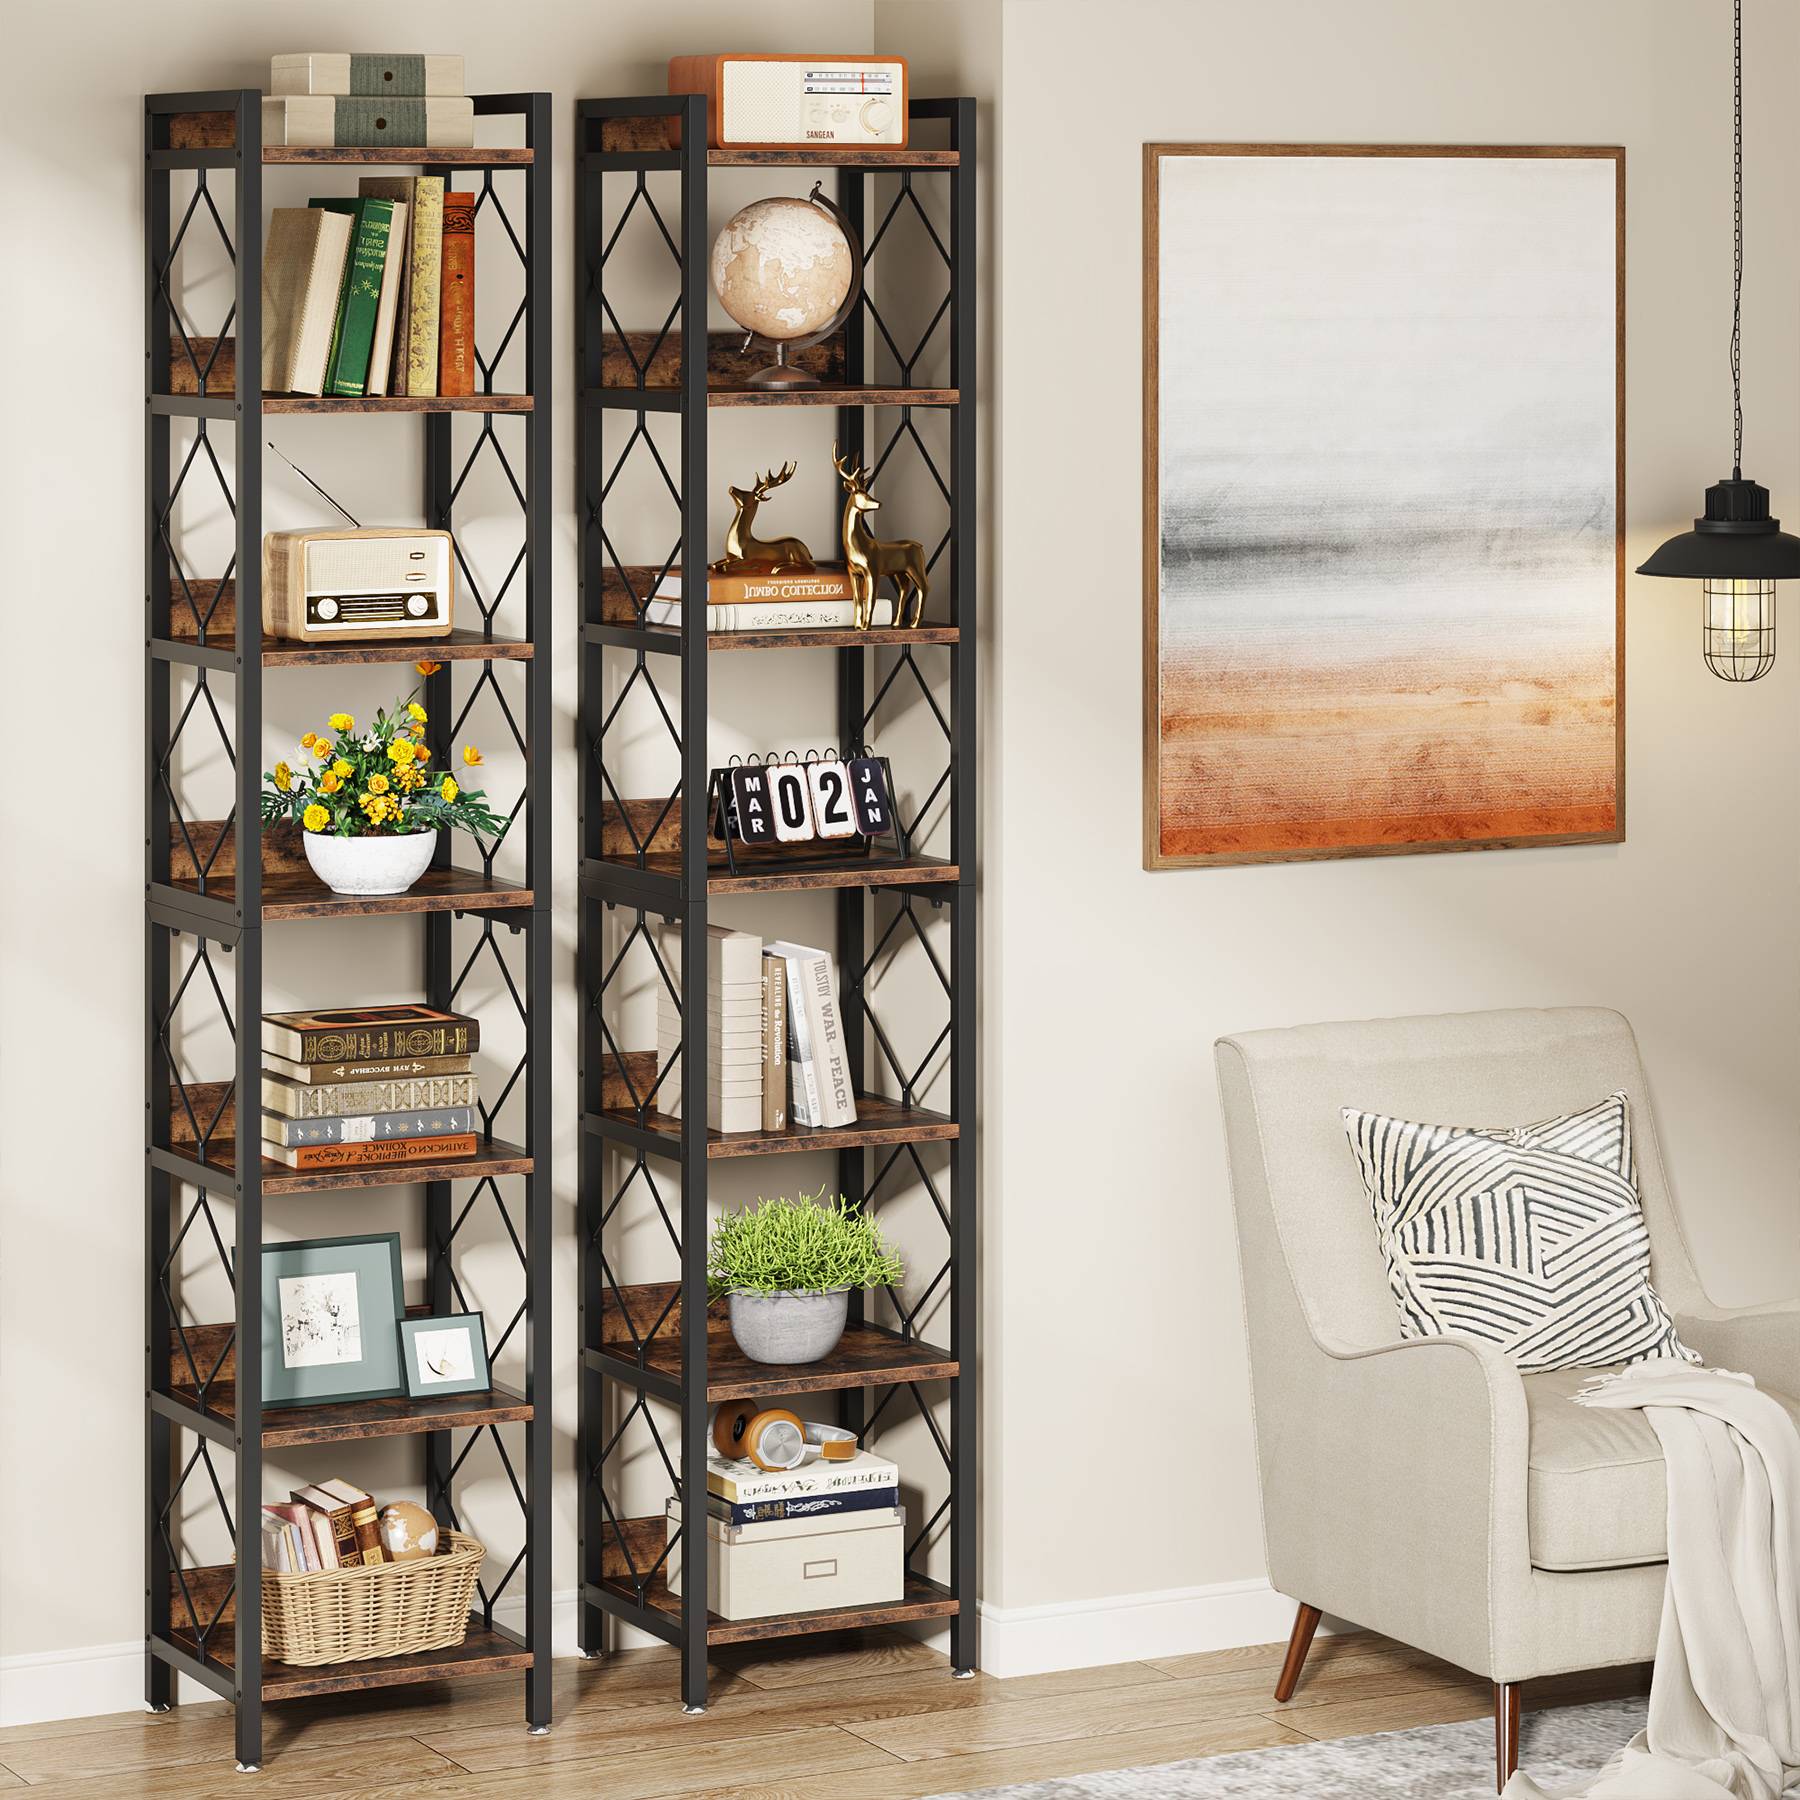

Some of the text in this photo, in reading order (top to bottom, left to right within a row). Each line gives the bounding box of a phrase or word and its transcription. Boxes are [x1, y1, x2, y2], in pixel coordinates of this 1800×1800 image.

[806, 130, 835, 139] SANGEAN
[744, 777, 764, 833] MAR
[861, 768, 882, 824] JAN
[774, 1020, 782, 1065] Revolution
[813, 959, 848, 1110] TOLSTOY WAR PEACE
[356, 1151, 407, 1162] ШЕРЛОКЕ
[362, 1142, 407, 1152] ХОЛМСЕ
[417, 1142, 469, 1152] ЗАПИСКИ
